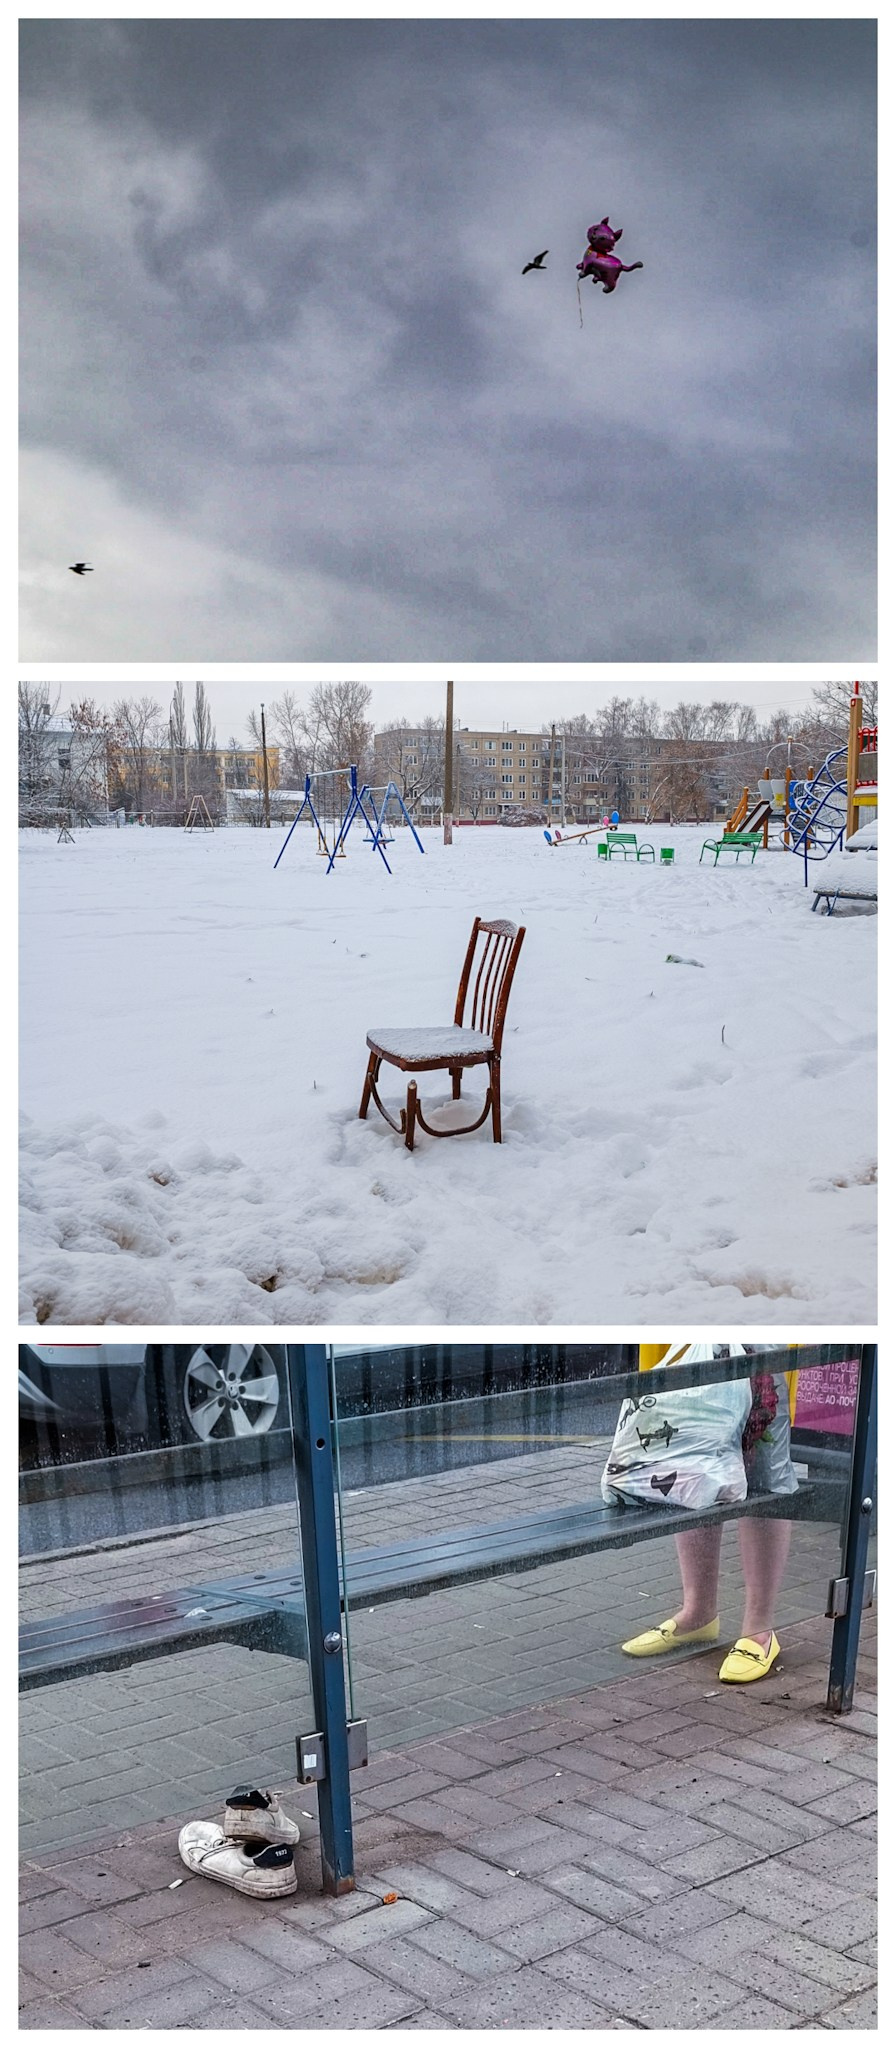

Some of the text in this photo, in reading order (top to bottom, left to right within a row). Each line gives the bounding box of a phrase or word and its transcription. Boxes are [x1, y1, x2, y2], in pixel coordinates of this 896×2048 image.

[830, 1372, 844, 1383] ПРИ
[797, 1392, 824, 1404] ВЫДАЧЕ
[825, 1394, 836, 1405] АО
